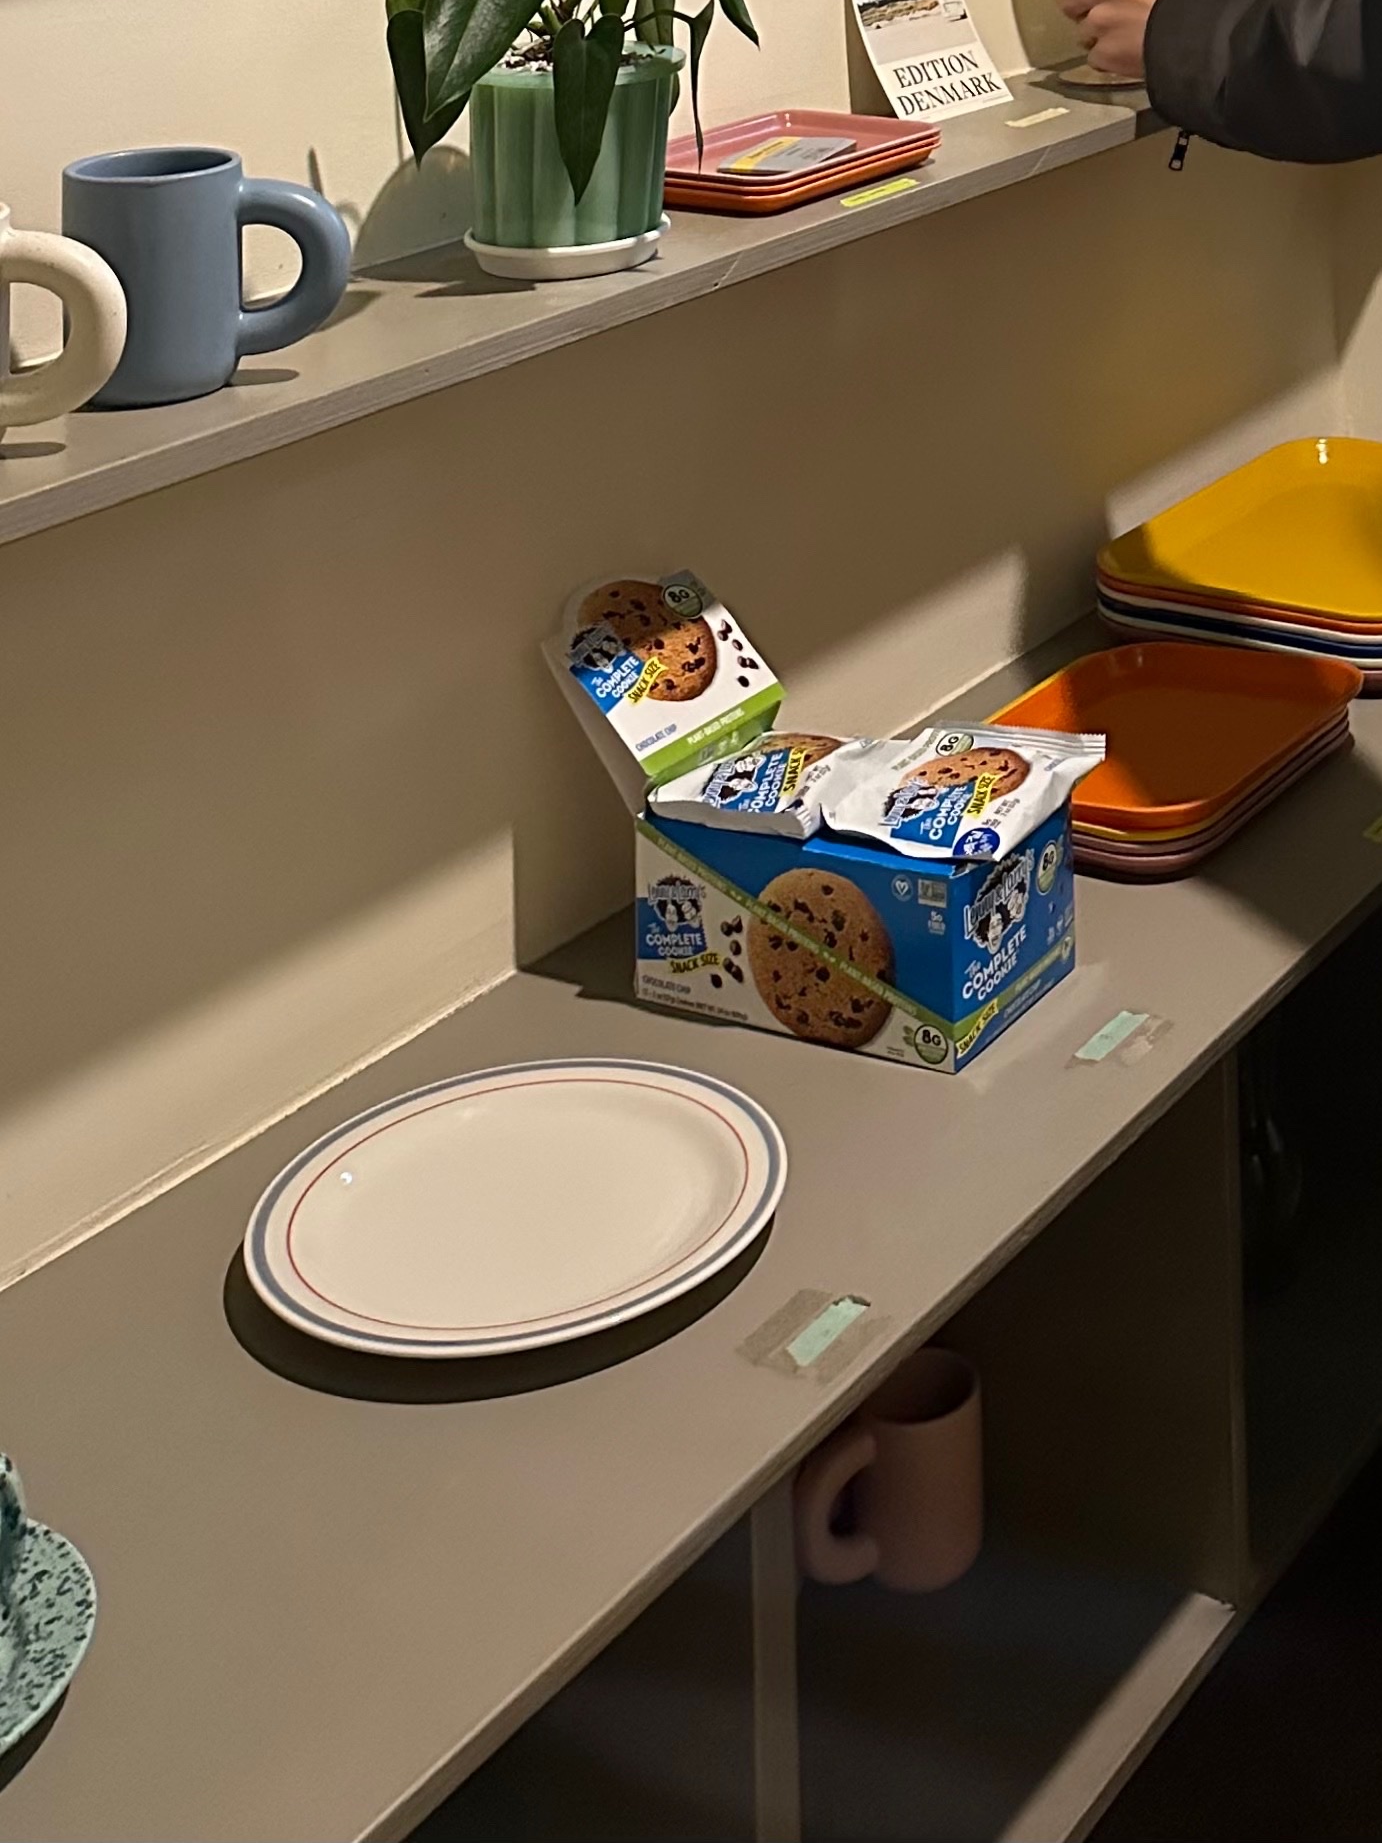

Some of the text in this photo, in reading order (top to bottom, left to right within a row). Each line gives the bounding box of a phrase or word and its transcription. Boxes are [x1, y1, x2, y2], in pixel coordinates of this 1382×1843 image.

[893, 50, 979, 89] EDITION
[897, 71, 1001, 116] DENMARK
[596, 656, 640, 698] COMPLETE
[612, 670, 640, 698] COOKIE
[628, 660, 661, 704] SNACK SIZE
[783, 757, 801, 793] SNACK
[928, 784, 968, 840] COMPLETE
[967, 791, 988, 815] SNACK
[978, 775, 995, 792] SIZE
[646, 932, 703, 946] COMPLETE
[658, 946, 693, 957] COOKIE
[670, 953, 720, 974] SNACK SIZE
[962, 927, 1027, 999] COMPLETE
[978, 952, 1018, 1000] COOKIE
[921, 1029, 942, 1046] 8G
[959, 1025, 981, 1055] SNACK
